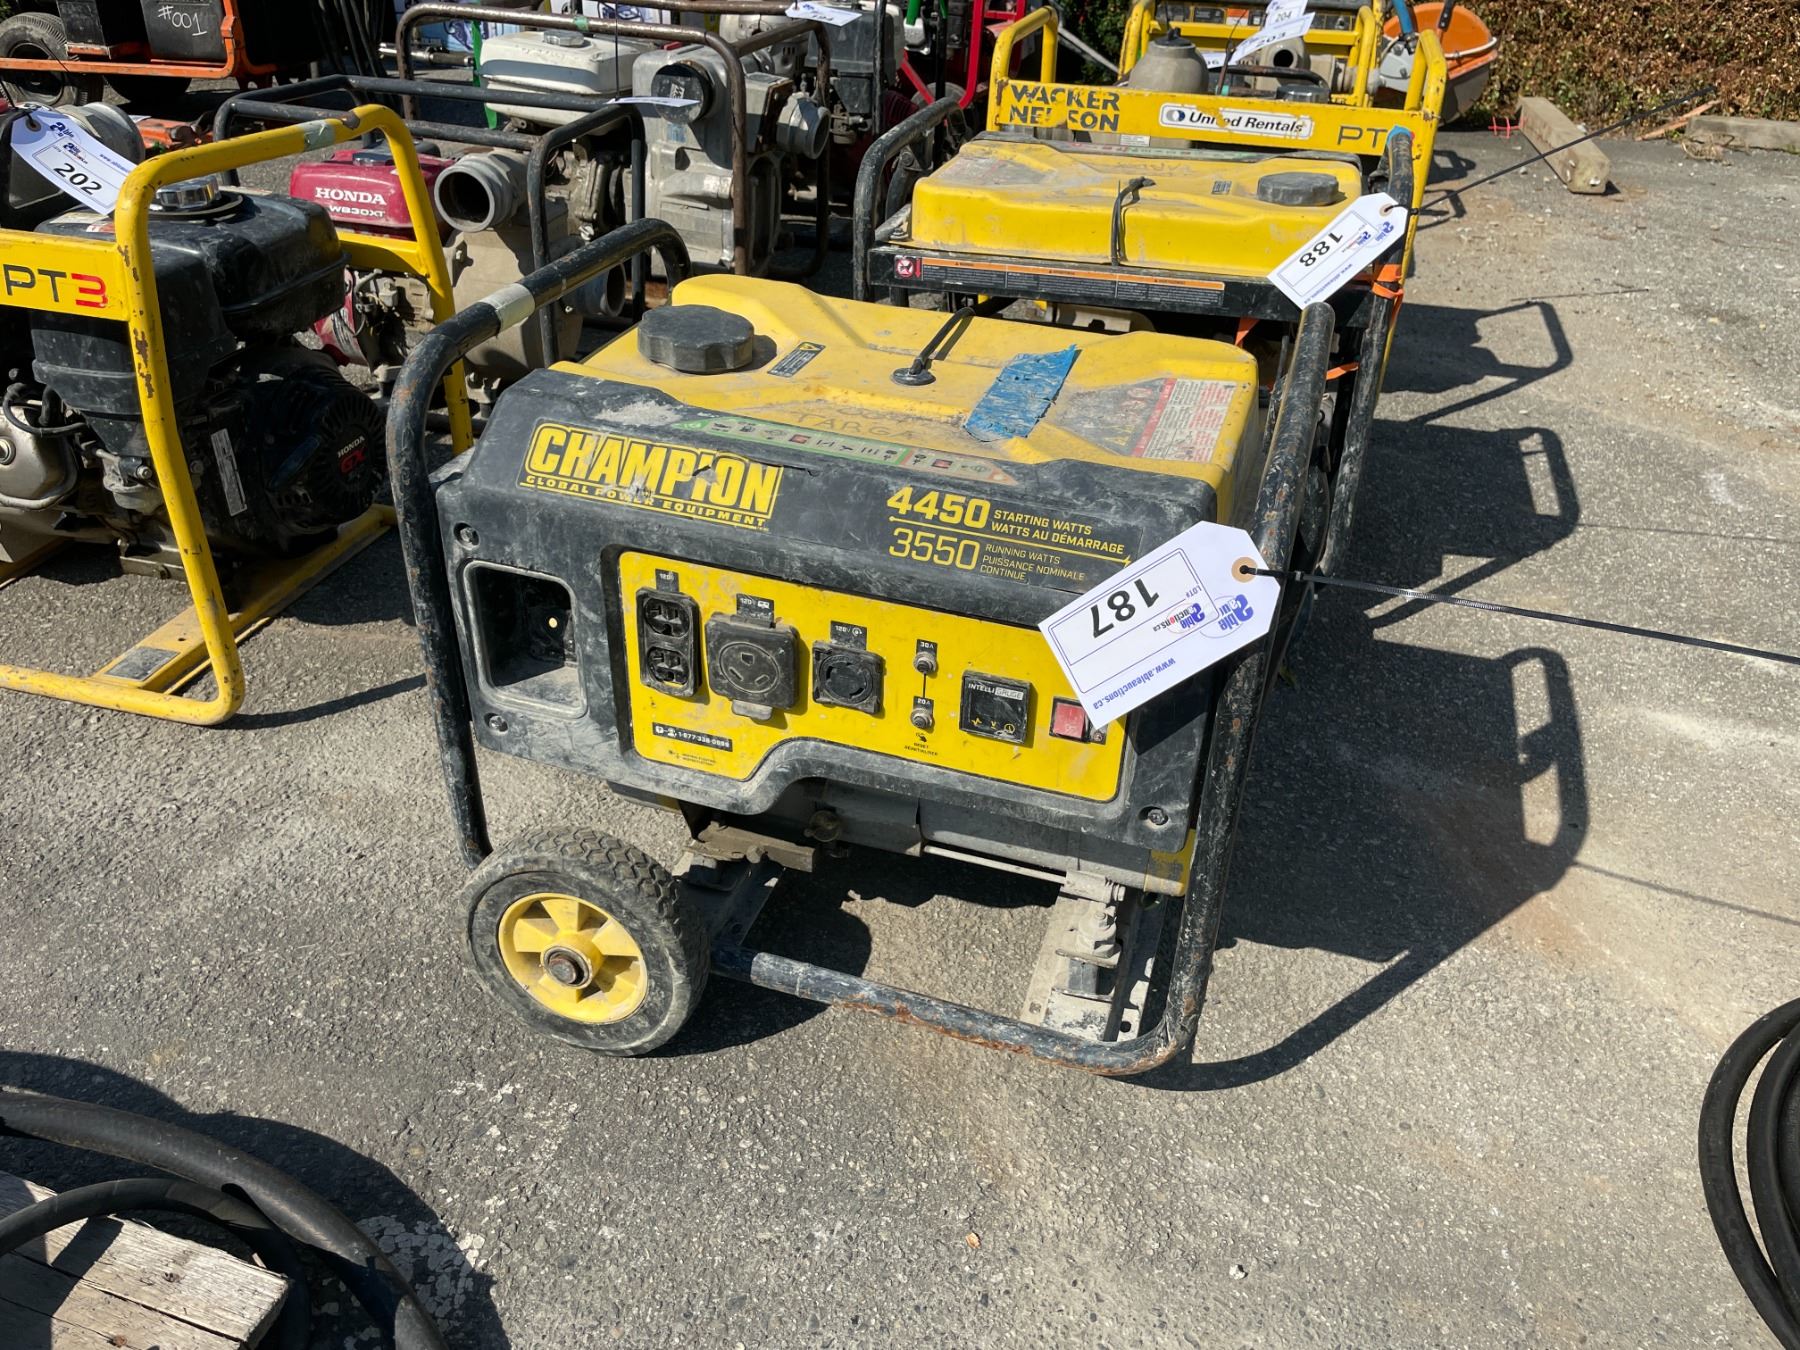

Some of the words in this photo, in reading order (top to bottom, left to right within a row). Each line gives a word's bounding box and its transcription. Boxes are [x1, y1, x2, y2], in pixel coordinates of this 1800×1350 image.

[157, 5, 208, 36] #001
[1010, 84, 1120, 111] WACKER
[1010, 105, 1120, 132] NESON
[1188, 111, 1242, 127] Unied
[1243, 116, 1304, 133] Rentals
[1337, 125, 1388, 149] PT
[53, 162, 102, 195] 202
[314, 186, 387, 206] HONDA
[1299, 232, 1343, 267] 188
[3, 264, 109, 309] PT3
[337, 435, 365, 458] HONDA
[530, 426, 779, 513] CHAMPION
[526, 475, 595, 495] GLOBAL
[597, 485, 655, 507] POWER
[662, 497, 768, 527] EQUIPMENT
[886, 486, 991, 529] 4450
[993, 509, 1050, 528] STARTING
[1052, 520, 1093, 536] WATTS
[888, 527, 980, 571] 3550
[984, 543, 1027, 561] RUNNING
[1029, 551, 1061, 565] WATTS
[991, 521, 1029, 538] WATTS
[1032, 528, 1050, 542] AU
[1051, 531, 1125, 556] DÉMARRAGE
[979, 564, 1026, 582] CONTINUE
[982, 554, 1035, 574] PUISSANCE
[1036, 564, 1086, 582] NOMINALE
[1090, 578, 1160, 639] 187
[1185, 585, 1203, 600] LOT#
[1093, 657, 1176, 710] www.ableauctions.ca
